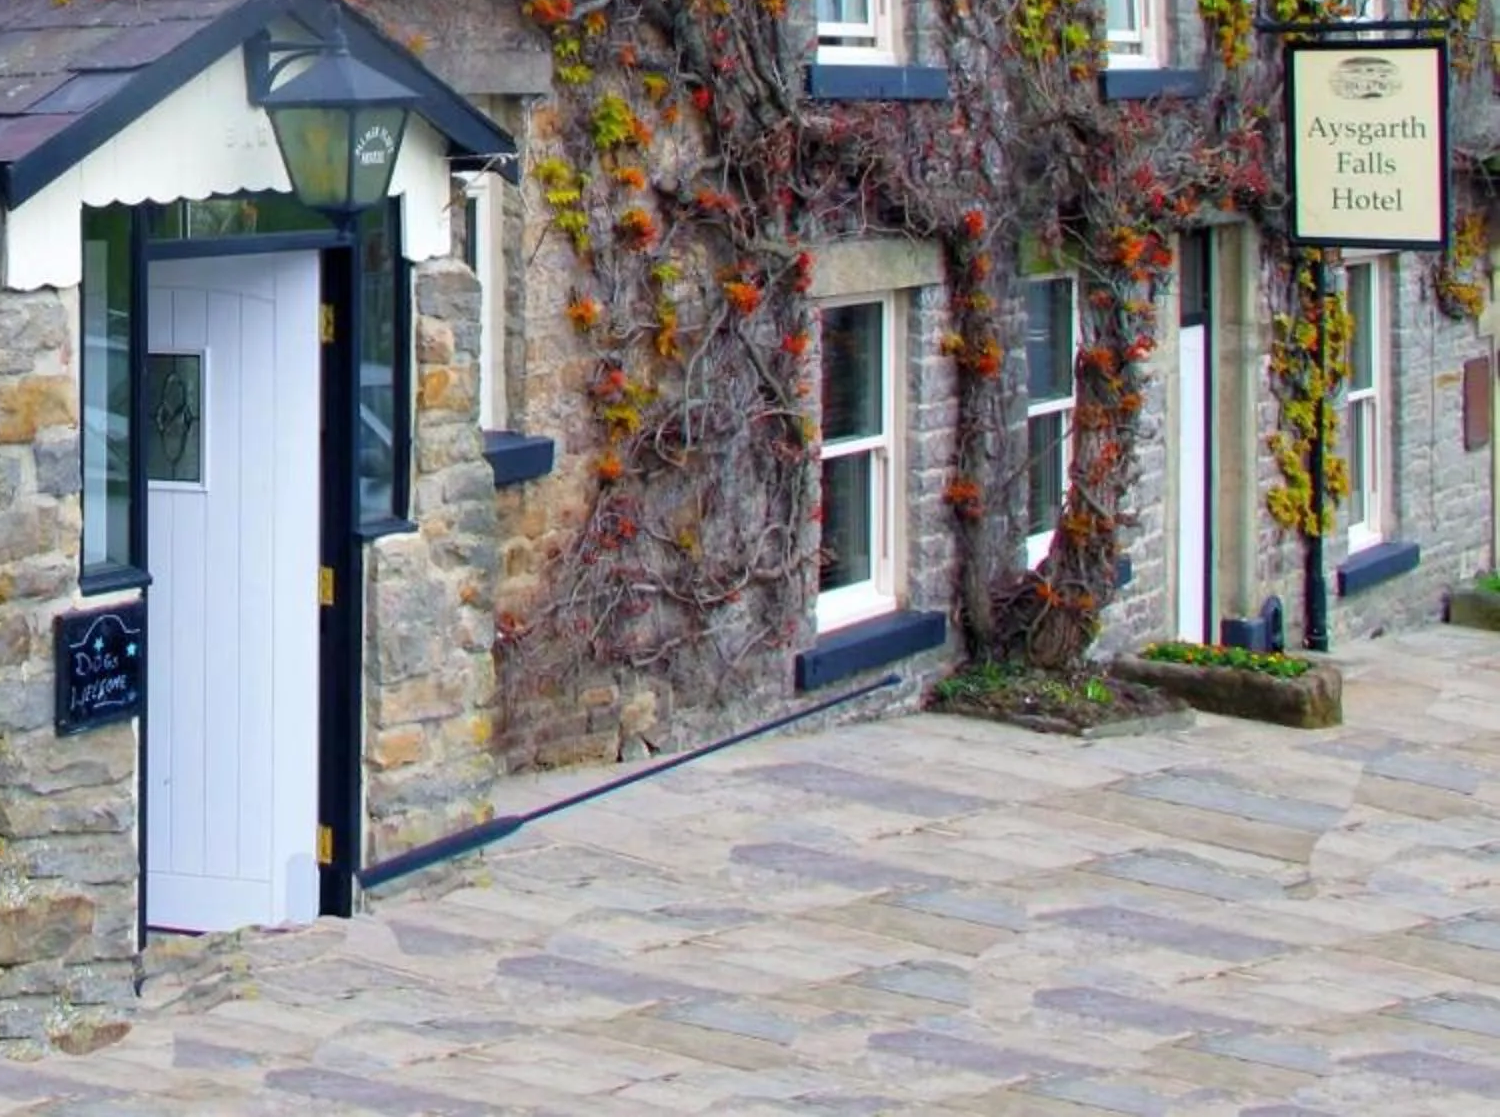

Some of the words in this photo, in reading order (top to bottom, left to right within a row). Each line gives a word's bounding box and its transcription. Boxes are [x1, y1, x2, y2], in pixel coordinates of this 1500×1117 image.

[1308, 116, 1426, 145] Aysgarth
[1337, 152, 1397, 174] Falls
[1331, 187, 1403, 211] Hotel
